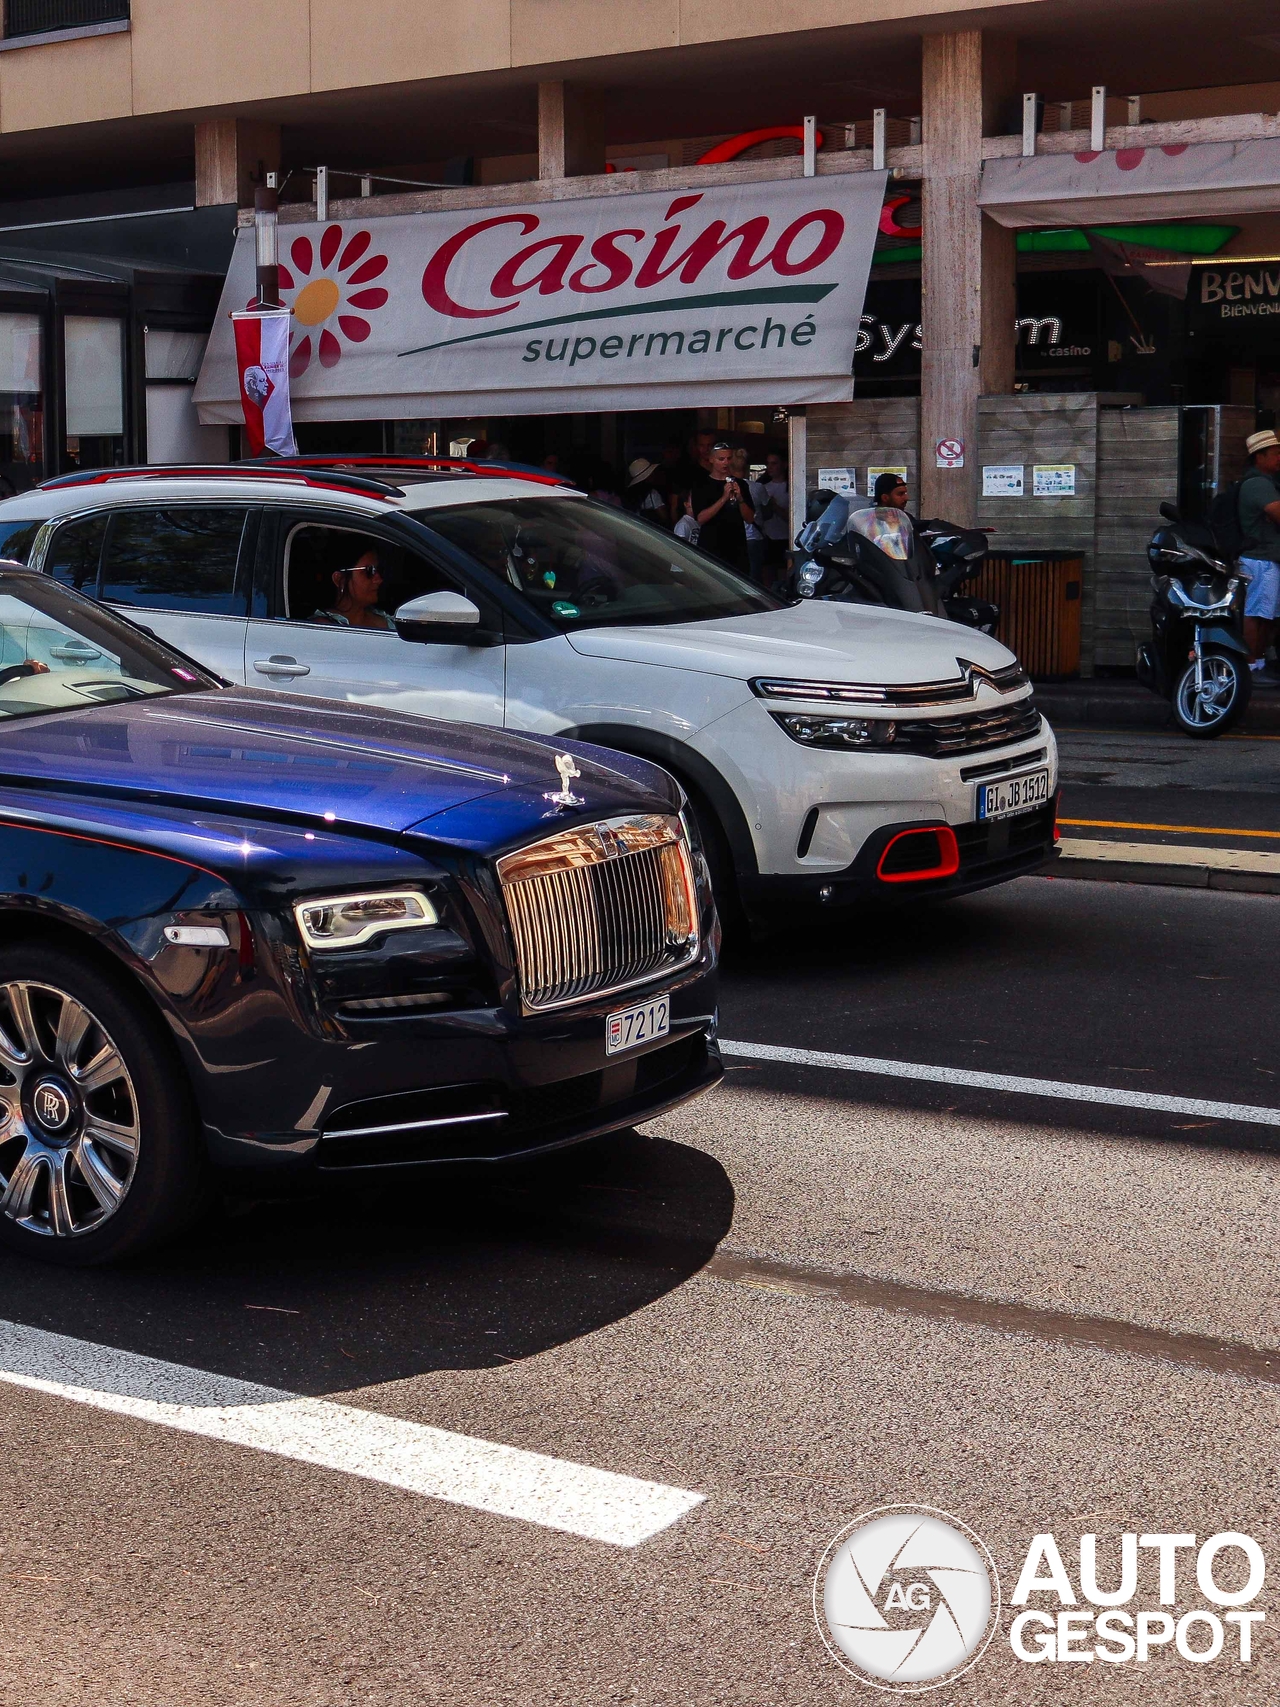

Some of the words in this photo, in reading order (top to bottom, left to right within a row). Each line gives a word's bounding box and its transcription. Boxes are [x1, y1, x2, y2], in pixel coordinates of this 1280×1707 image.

[522, 313, 816, 367] supermarché
[987, 786, 999, 813] GI
[1008, 781, 1020, 807] JB
[1022, 775, 1046, 804] 1512
[625, 1003, 667, 1044] 7212
